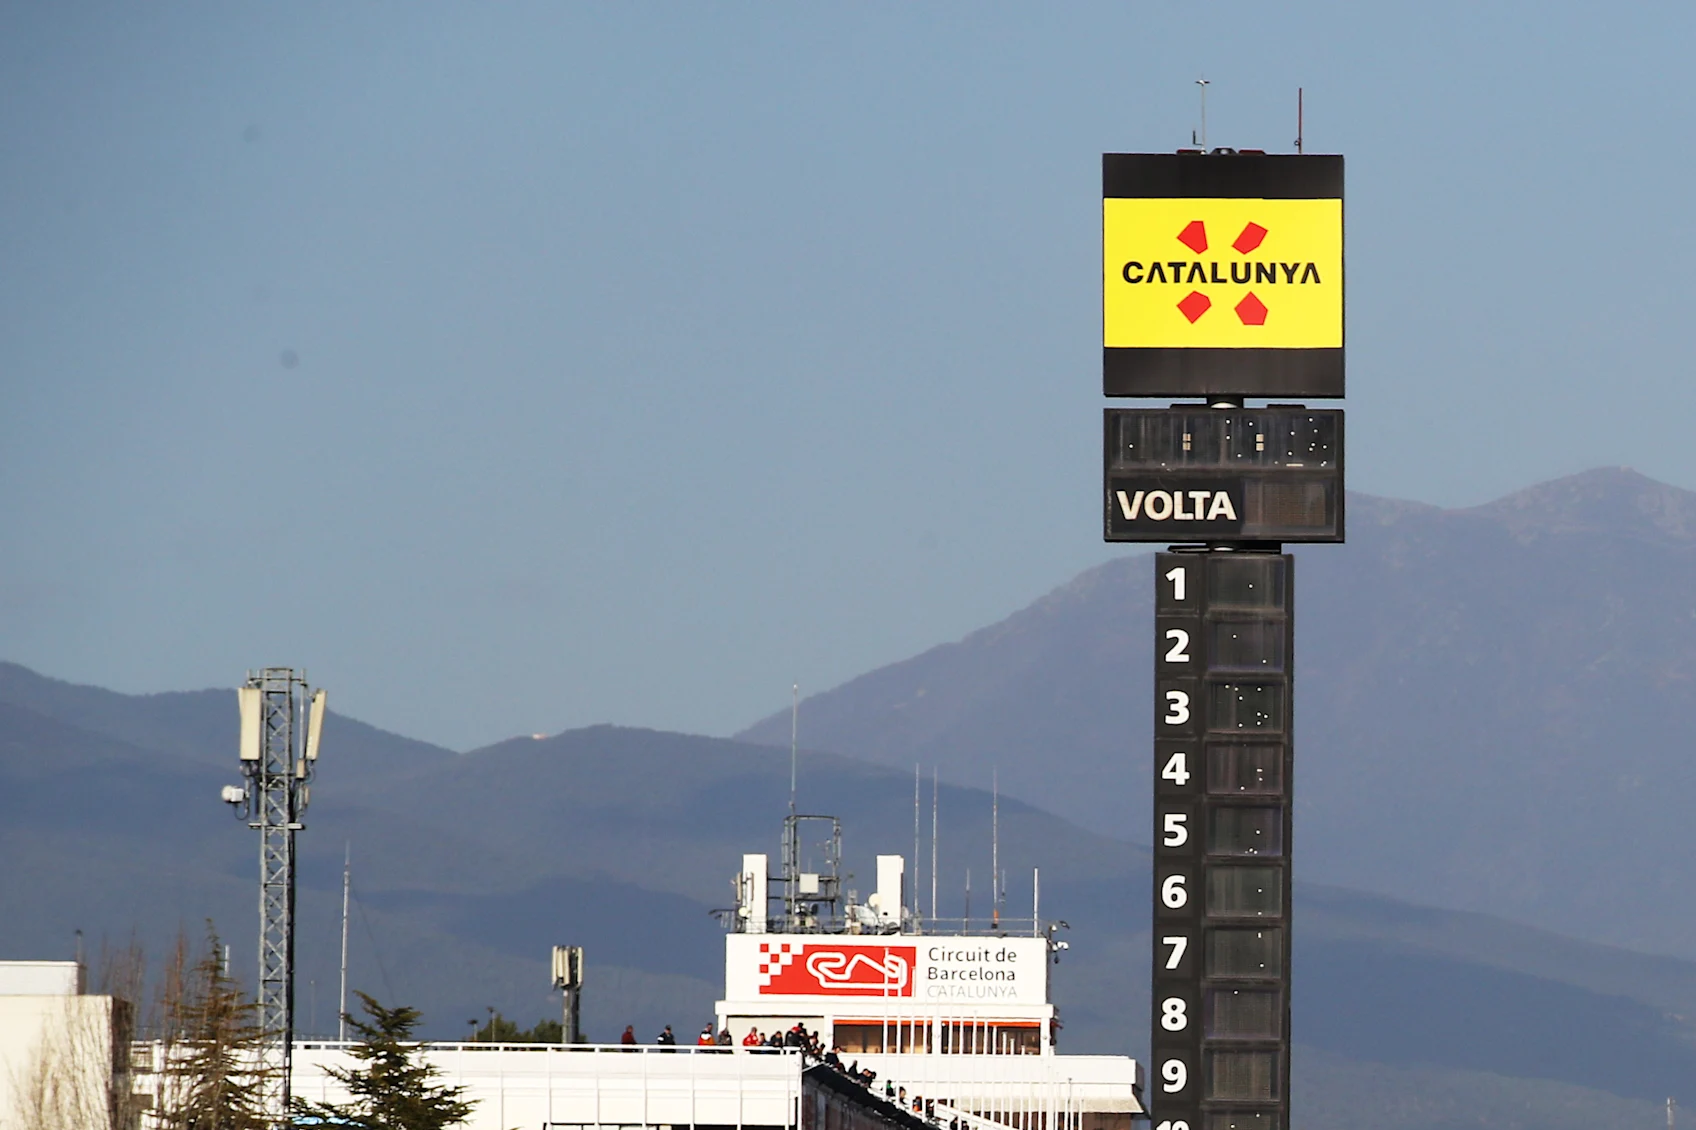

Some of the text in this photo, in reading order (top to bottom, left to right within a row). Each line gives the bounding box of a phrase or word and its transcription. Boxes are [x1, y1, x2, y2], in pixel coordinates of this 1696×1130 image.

[1122, 261, 1321, 284] CATALUNYA
[1116, 490, 1237, 521] VOLTA
[1165, 567, 1185, 600] 1
[1165, 629, 1190, 663] 2
[1165, 691, 1190, 725] 3
[1161, 753, 1190, 785] 4
[1163, 814, 1188, 847] 5
[1161, 875, 1187, 909] 6
[928, 946, 1018, 962] Circuit de
[1162, 936, 1188, 969] 7
[928, 966, 1016, 981] Barcelona
[927, 985, 1018, 998] CATALUNYA
[1161, 997, 1188, 1031] 8
[1161, 1059, 1187, 1093] 9
